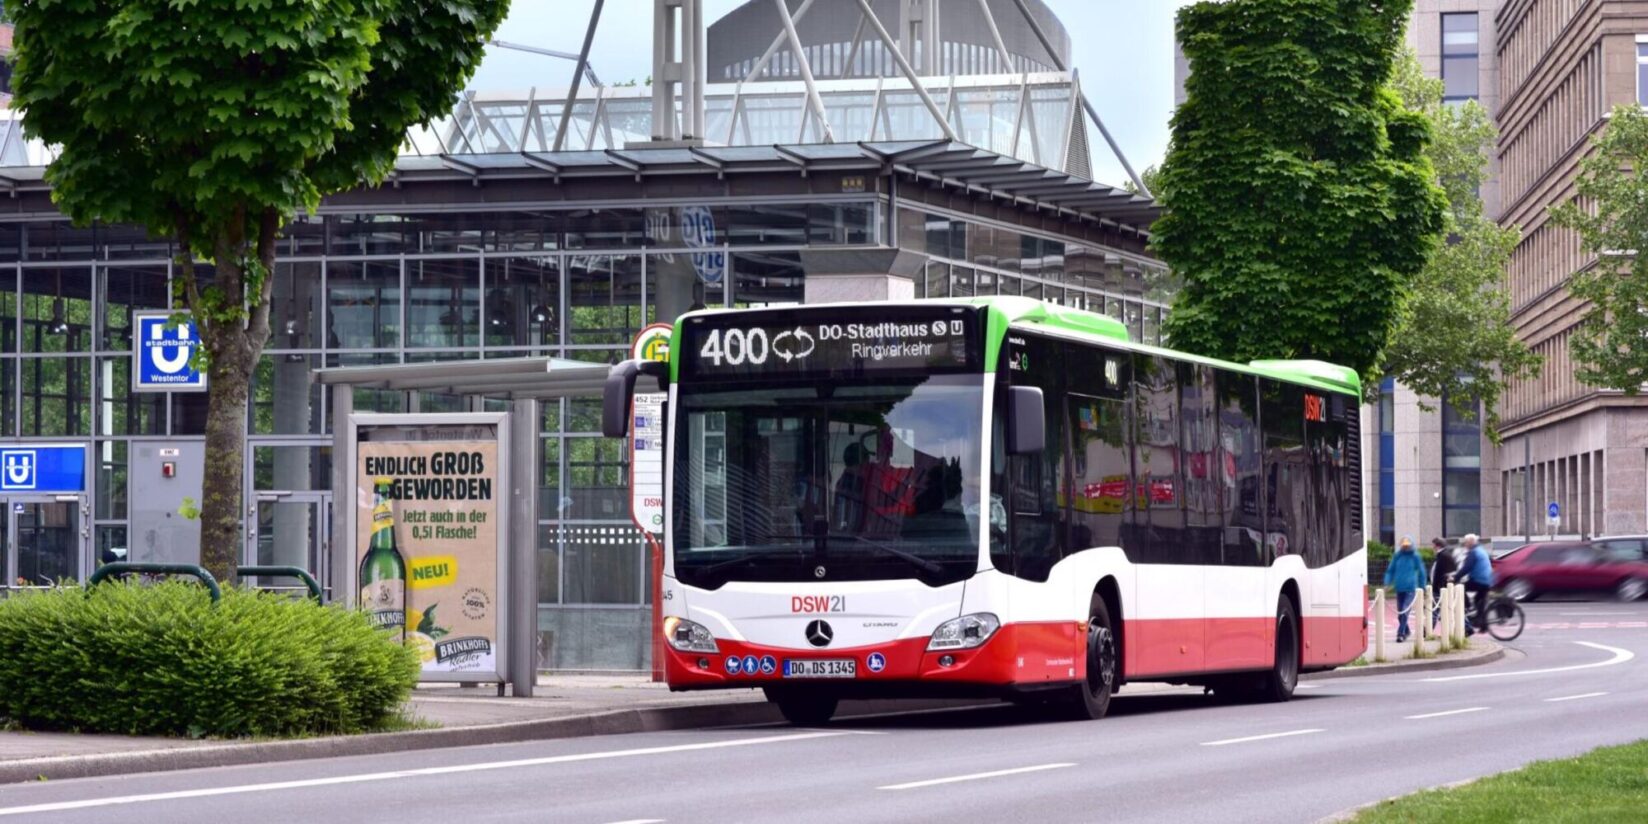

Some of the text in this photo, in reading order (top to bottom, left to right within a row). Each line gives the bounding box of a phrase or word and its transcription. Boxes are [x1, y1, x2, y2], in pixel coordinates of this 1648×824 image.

[146, 339, 195, 347] stadtbahn
[701, 328, 768, 365] 400
[819, 324, 928, 340] DO-Stadthaus
[852, 341, 933, 360] Ringverkehr
[1105, 360, 1117, 385] 400
[1305, 394, 1326, 422] DSW21
[365, 456, 427, 475] ENDLICH
[391, 478, 492, 500] GEWORDEN
[402, 509, 426, 522] Jetzt
[430, 509, 454, 522] auch
[456, 509, 466, 522] in
[469, 509, 487, 522] der
[412, 525, 477, 541] 0,5l Flasche!
[412, 563, 449, 580] NEU!
[466, 599, 485, 609] 100%
[791, 595, 846, 613] DSW21
[791, 662, 855, 674] DO DS 1345
